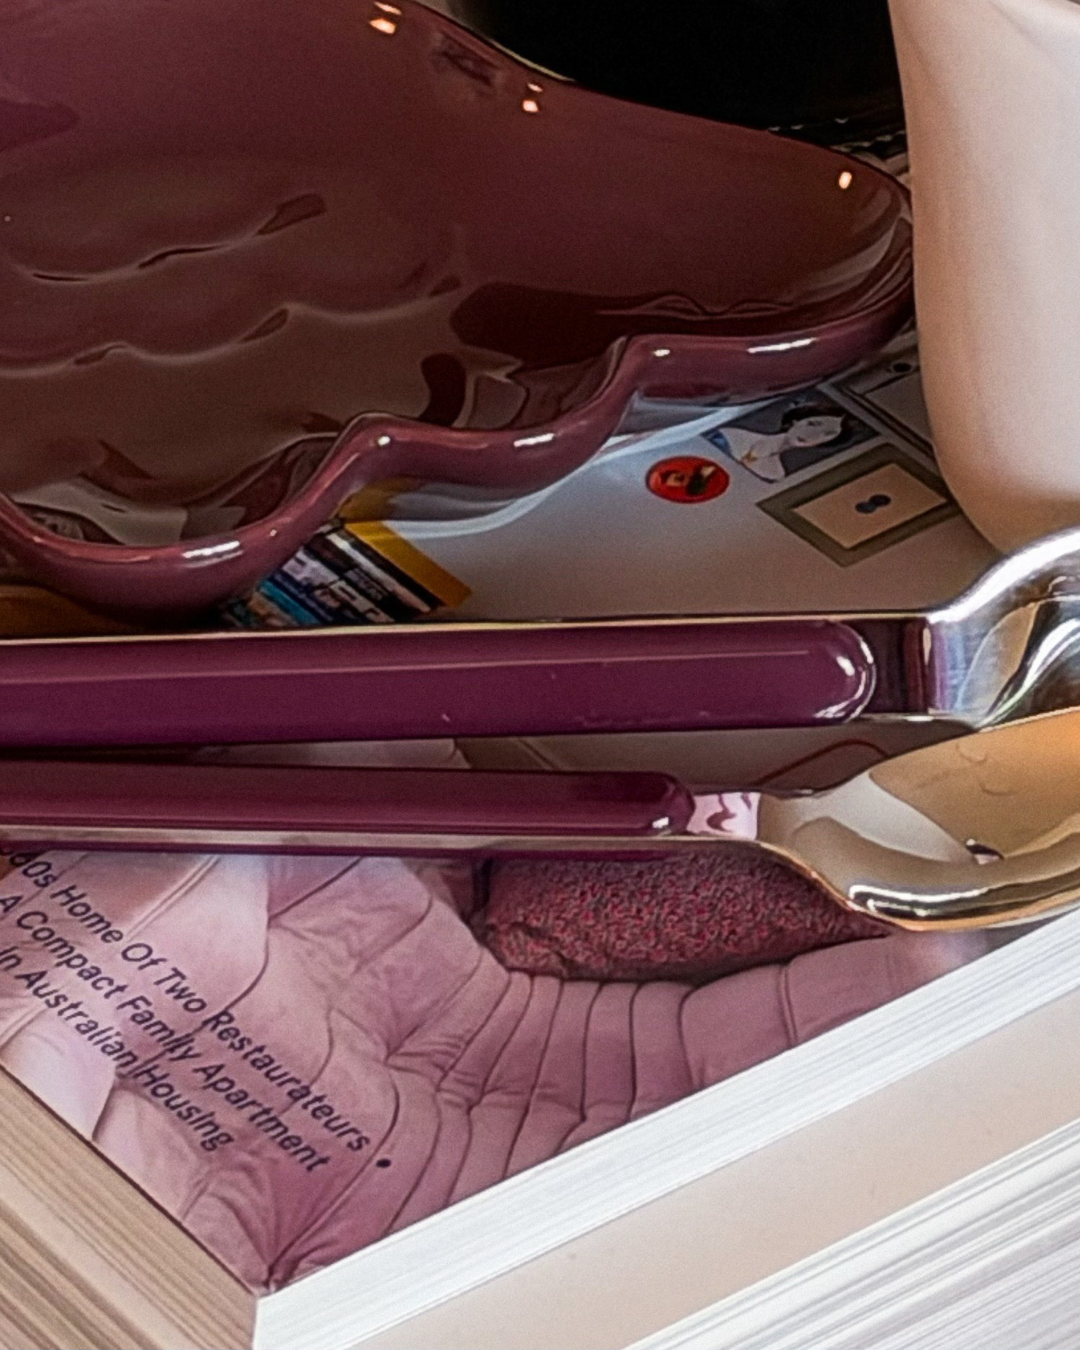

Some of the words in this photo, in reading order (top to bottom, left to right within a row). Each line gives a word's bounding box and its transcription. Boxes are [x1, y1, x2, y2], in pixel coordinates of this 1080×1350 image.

[0, 895, 23, 913] A
[17, 911, 128, 999] Compact
[116, 995, 202, 1062] Family
[192, 1064, 330, 1172] Apartment
[14, 971, 138, 1068] Australian
[132, 1064, 234, 1151] Housing
[50, 884, 123, 943] Home
[121, 943, 167, 970] Of
[154, 967, 207, 1012] Two
[202, 1010, 370, 1151] Restaurateurs
